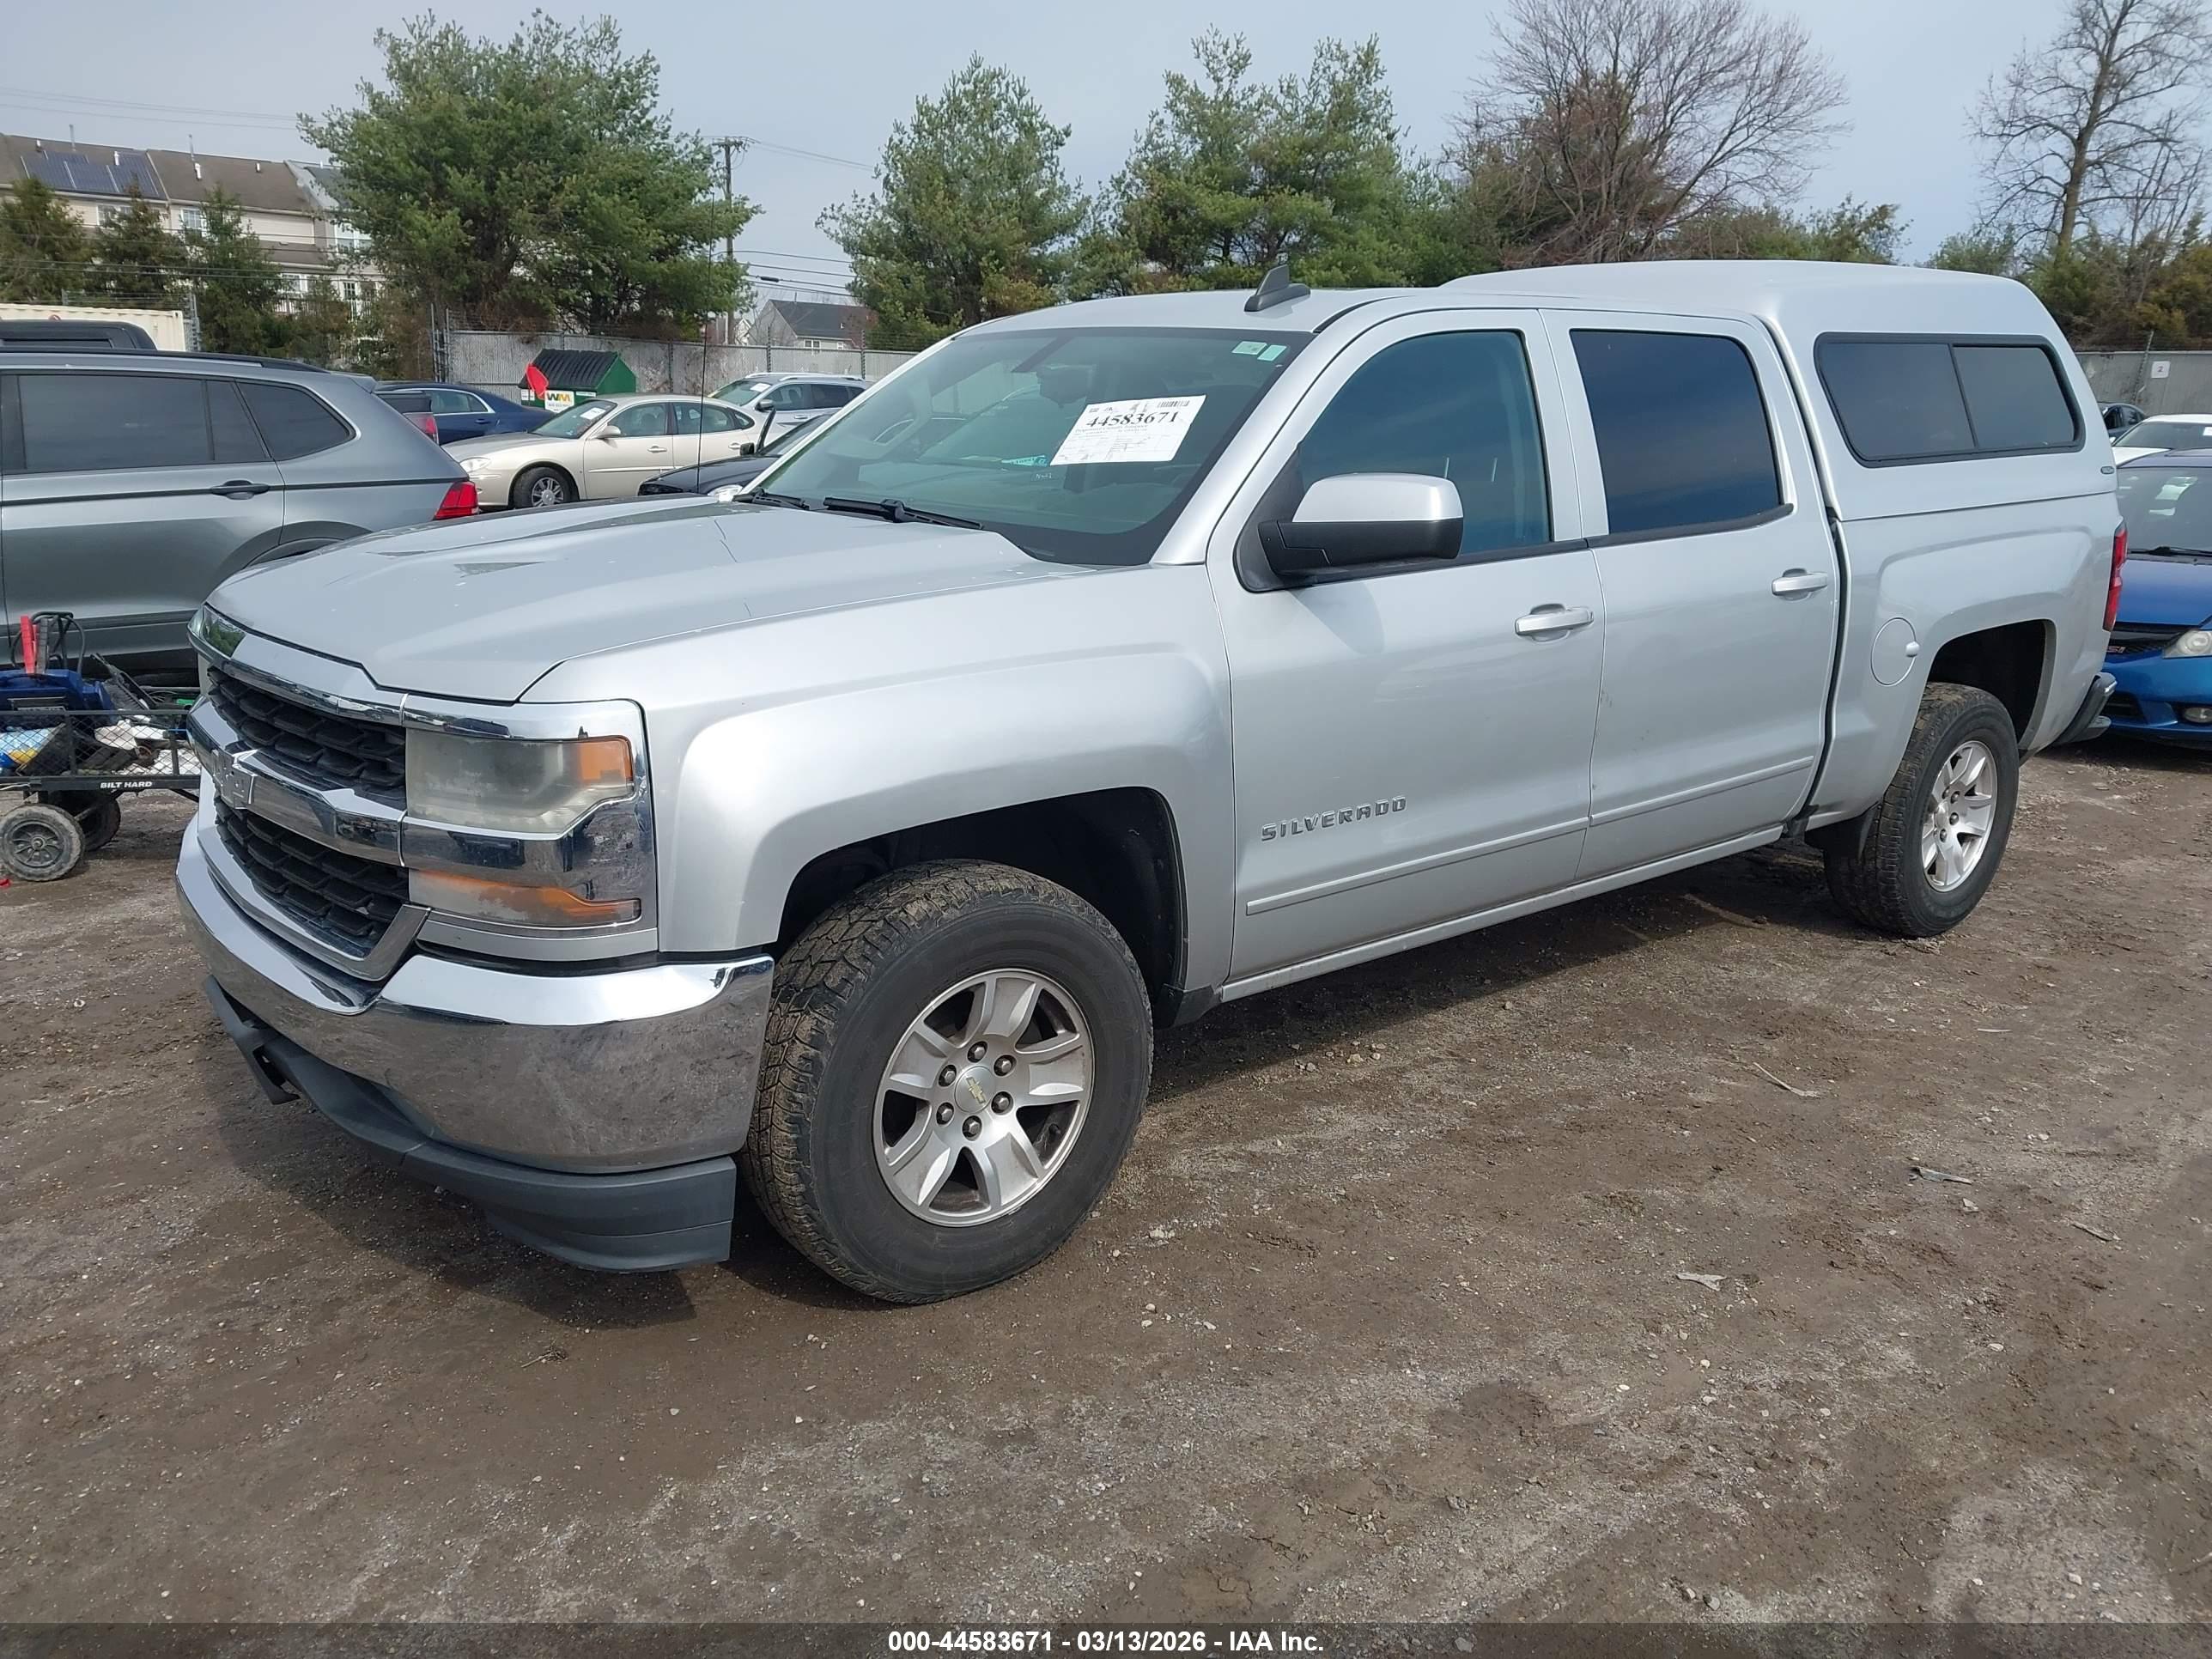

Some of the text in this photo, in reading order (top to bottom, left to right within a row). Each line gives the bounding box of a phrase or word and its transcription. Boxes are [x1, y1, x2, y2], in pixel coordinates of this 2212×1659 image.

[546, 392, 570, 401] WM
[1086, 411, 1179, 427] 44583671
[1261, 795, 1407, 842] SILVERADO
